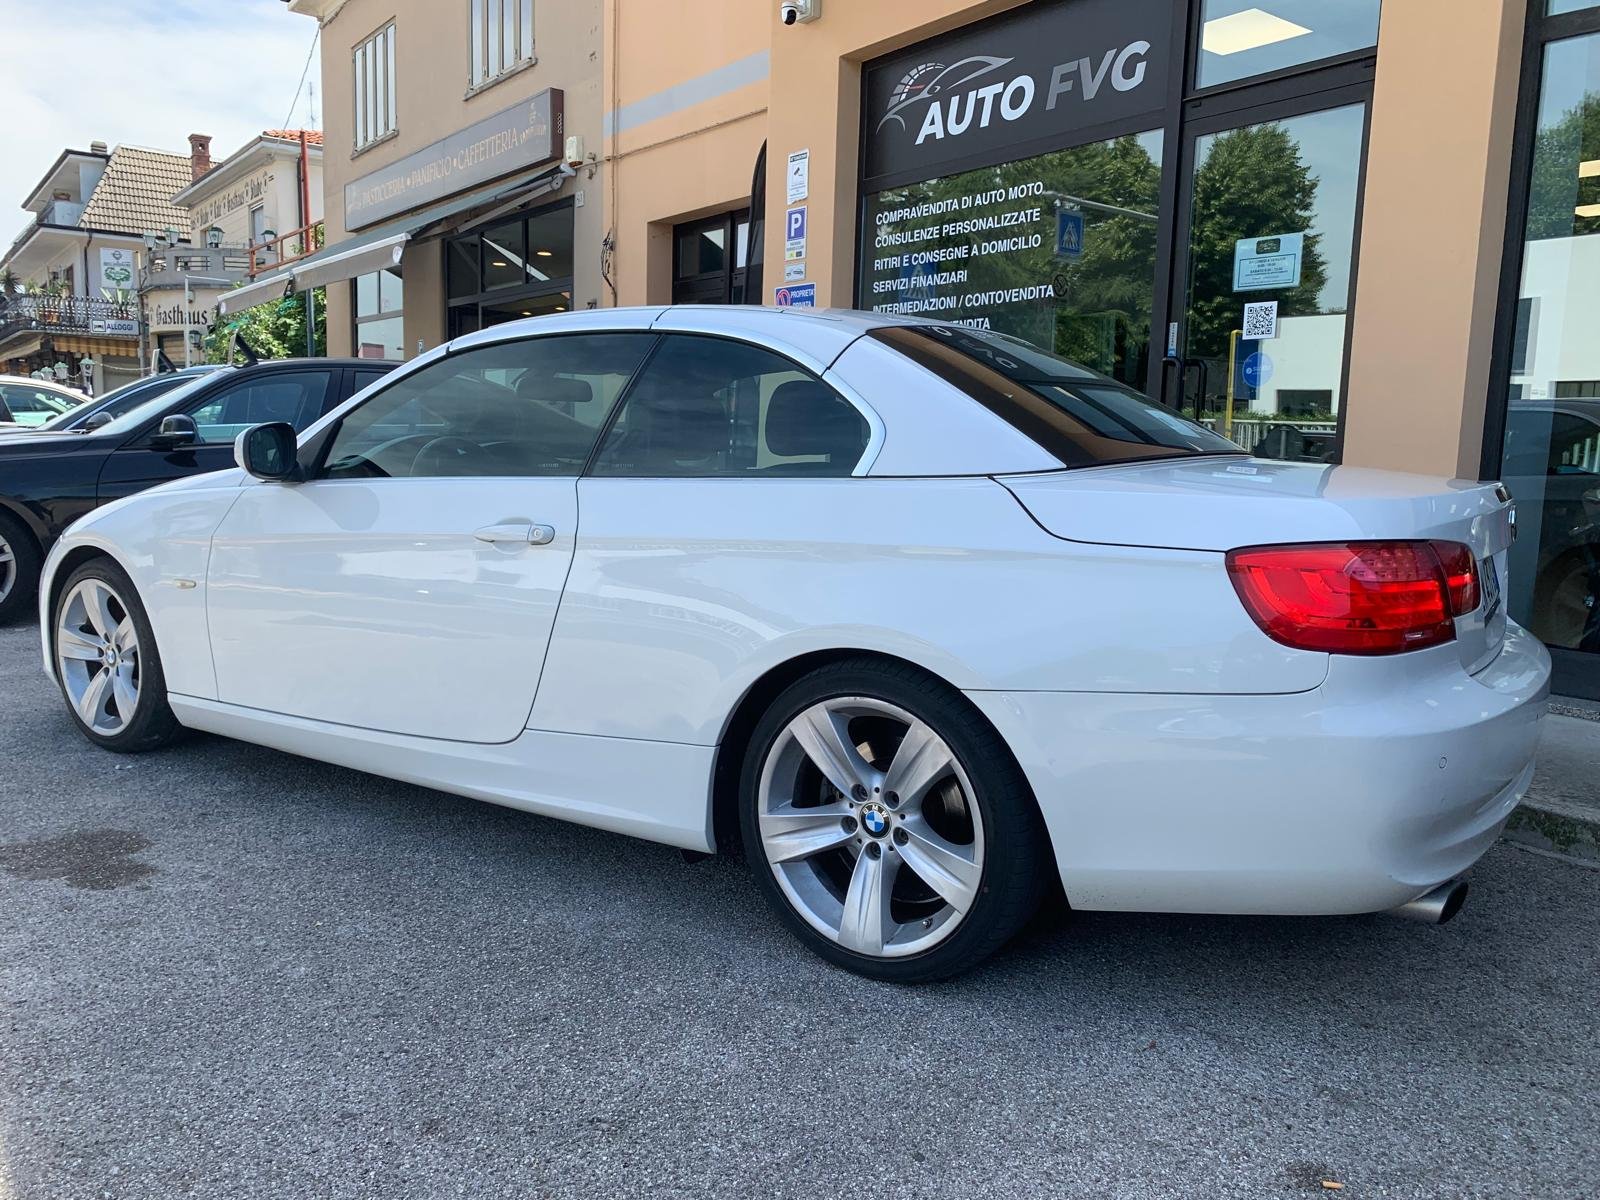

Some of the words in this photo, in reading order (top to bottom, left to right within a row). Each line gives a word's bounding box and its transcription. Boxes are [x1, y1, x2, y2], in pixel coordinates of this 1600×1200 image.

[914, 75, 1035, 146] AUTO
[1045, 40, 1150, 111] FVG
[411, 156, 452, 188] PANIFICIO
[458, 127, 519, 170] CAFFETTERIA
[876, 199, 959, 226] COMPRAVENDITA
[962, 196, 972, 209] DI
[974, 189, 1006, 206] AUTO
[1008, 181, 1044, 200] MOTO
[791, 213, 802, 237] P
[875, 226, 940, 248] CONSULENZE
[942, 208, 1041, 237] PERSONALIZZATE
[874, 256, 900, 271] RITIRI
[903, 254, 909, 267] E
[911, 246, 968, 265] CONSEGNE
[971, 244, 979, 256] A
[981, 234, 1042, 256] DOMICILIO
[873, 279, 909, 294] SERVIZI
[911, 270, 968, 290] FINANZIARI
[873, 296, 957, 314] INTERMEDIAZIONI
[958, 295, 964, 308] /
[965, 284, 1054, 307] CONTOVENDITA
[106, 323, 134, 331] ALLOGGI
[156, 304, 208, 326] Gasthaus
[862, 804, 888, 818] BMW
